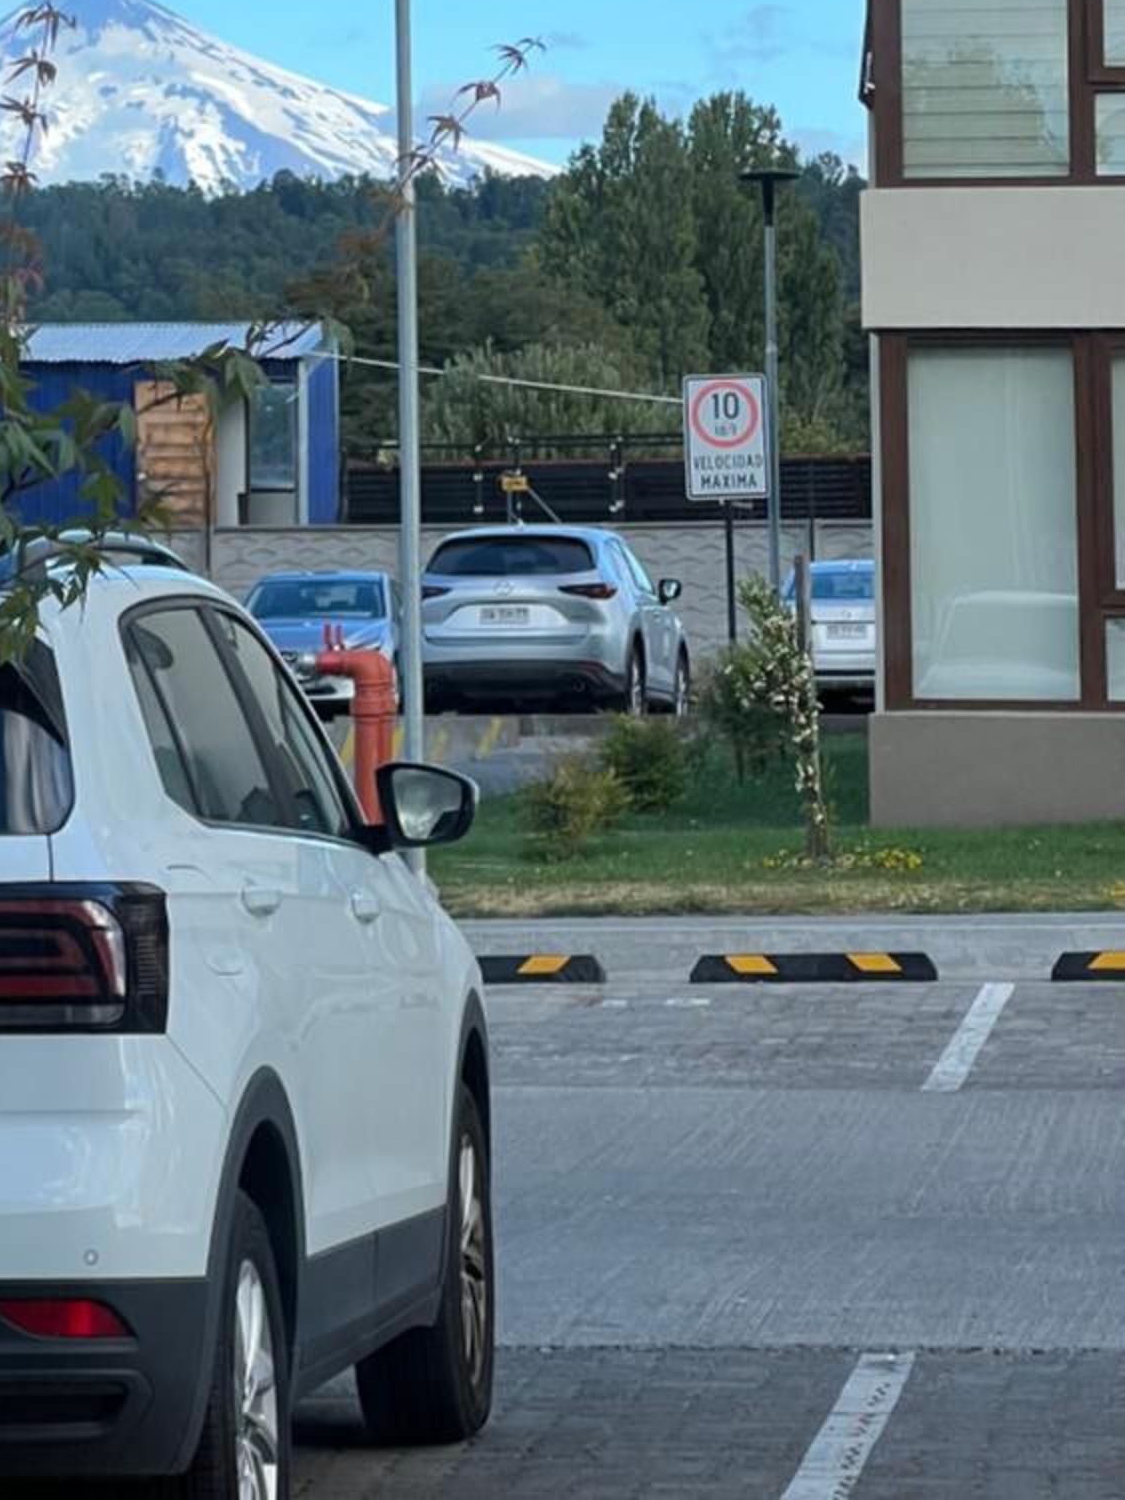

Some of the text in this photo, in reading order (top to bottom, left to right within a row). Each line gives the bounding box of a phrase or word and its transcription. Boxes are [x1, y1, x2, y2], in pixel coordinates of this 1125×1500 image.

[711, 391, 740, 420] 10
[693, 453, 763, 470] VELOCIDAD
[700, 473, 758, 489] MAXIMA
